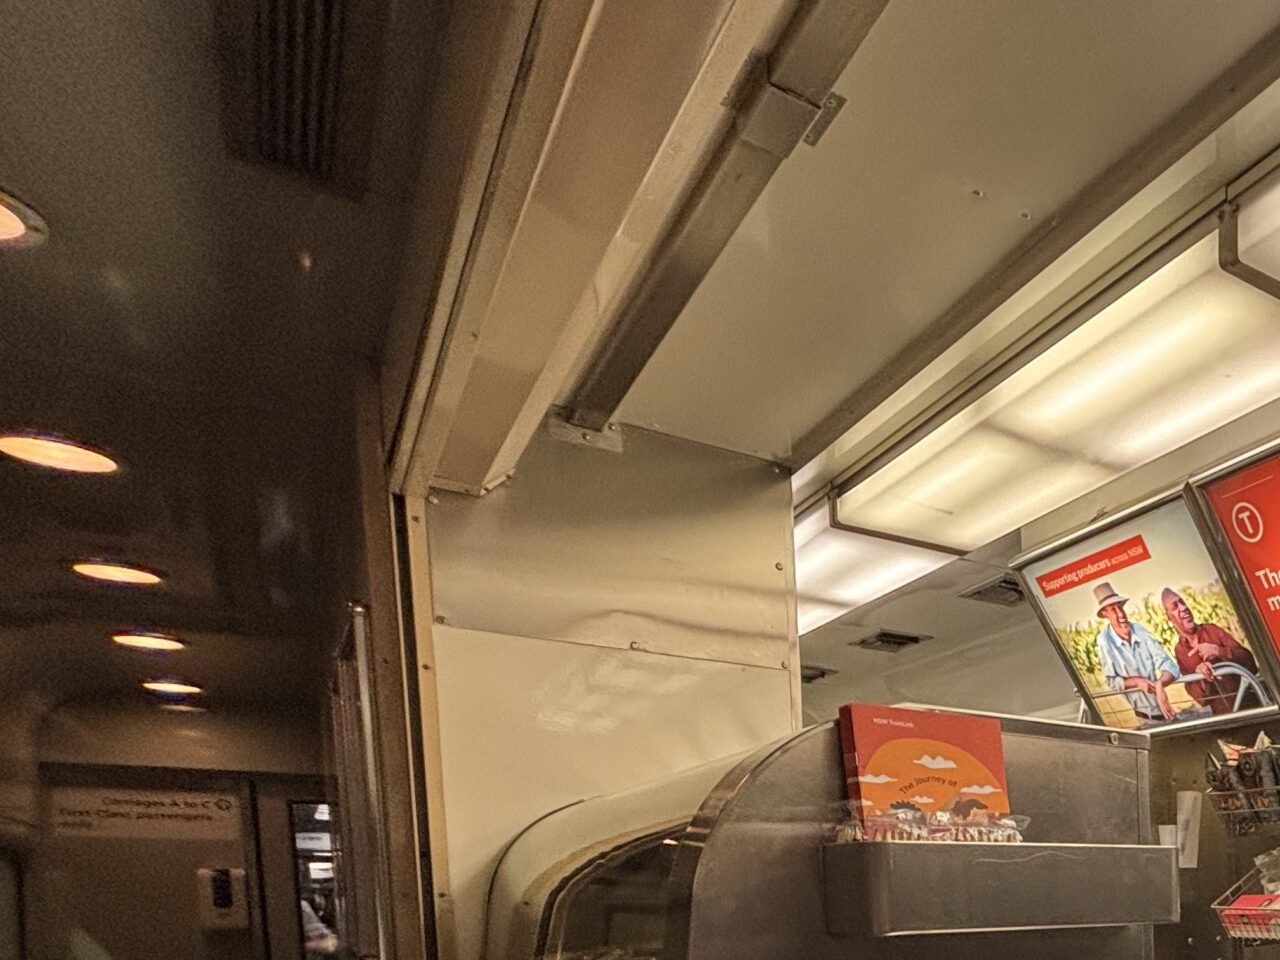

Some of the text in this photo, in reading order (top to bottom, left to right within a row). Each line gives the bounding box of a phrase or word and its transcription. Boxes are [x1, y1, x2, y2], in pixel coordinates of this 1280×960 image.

[1042, 570, 1079, 591] Supporting
[1077, 558, 1111, 580] producers
[899, 781, 914, 795] The
